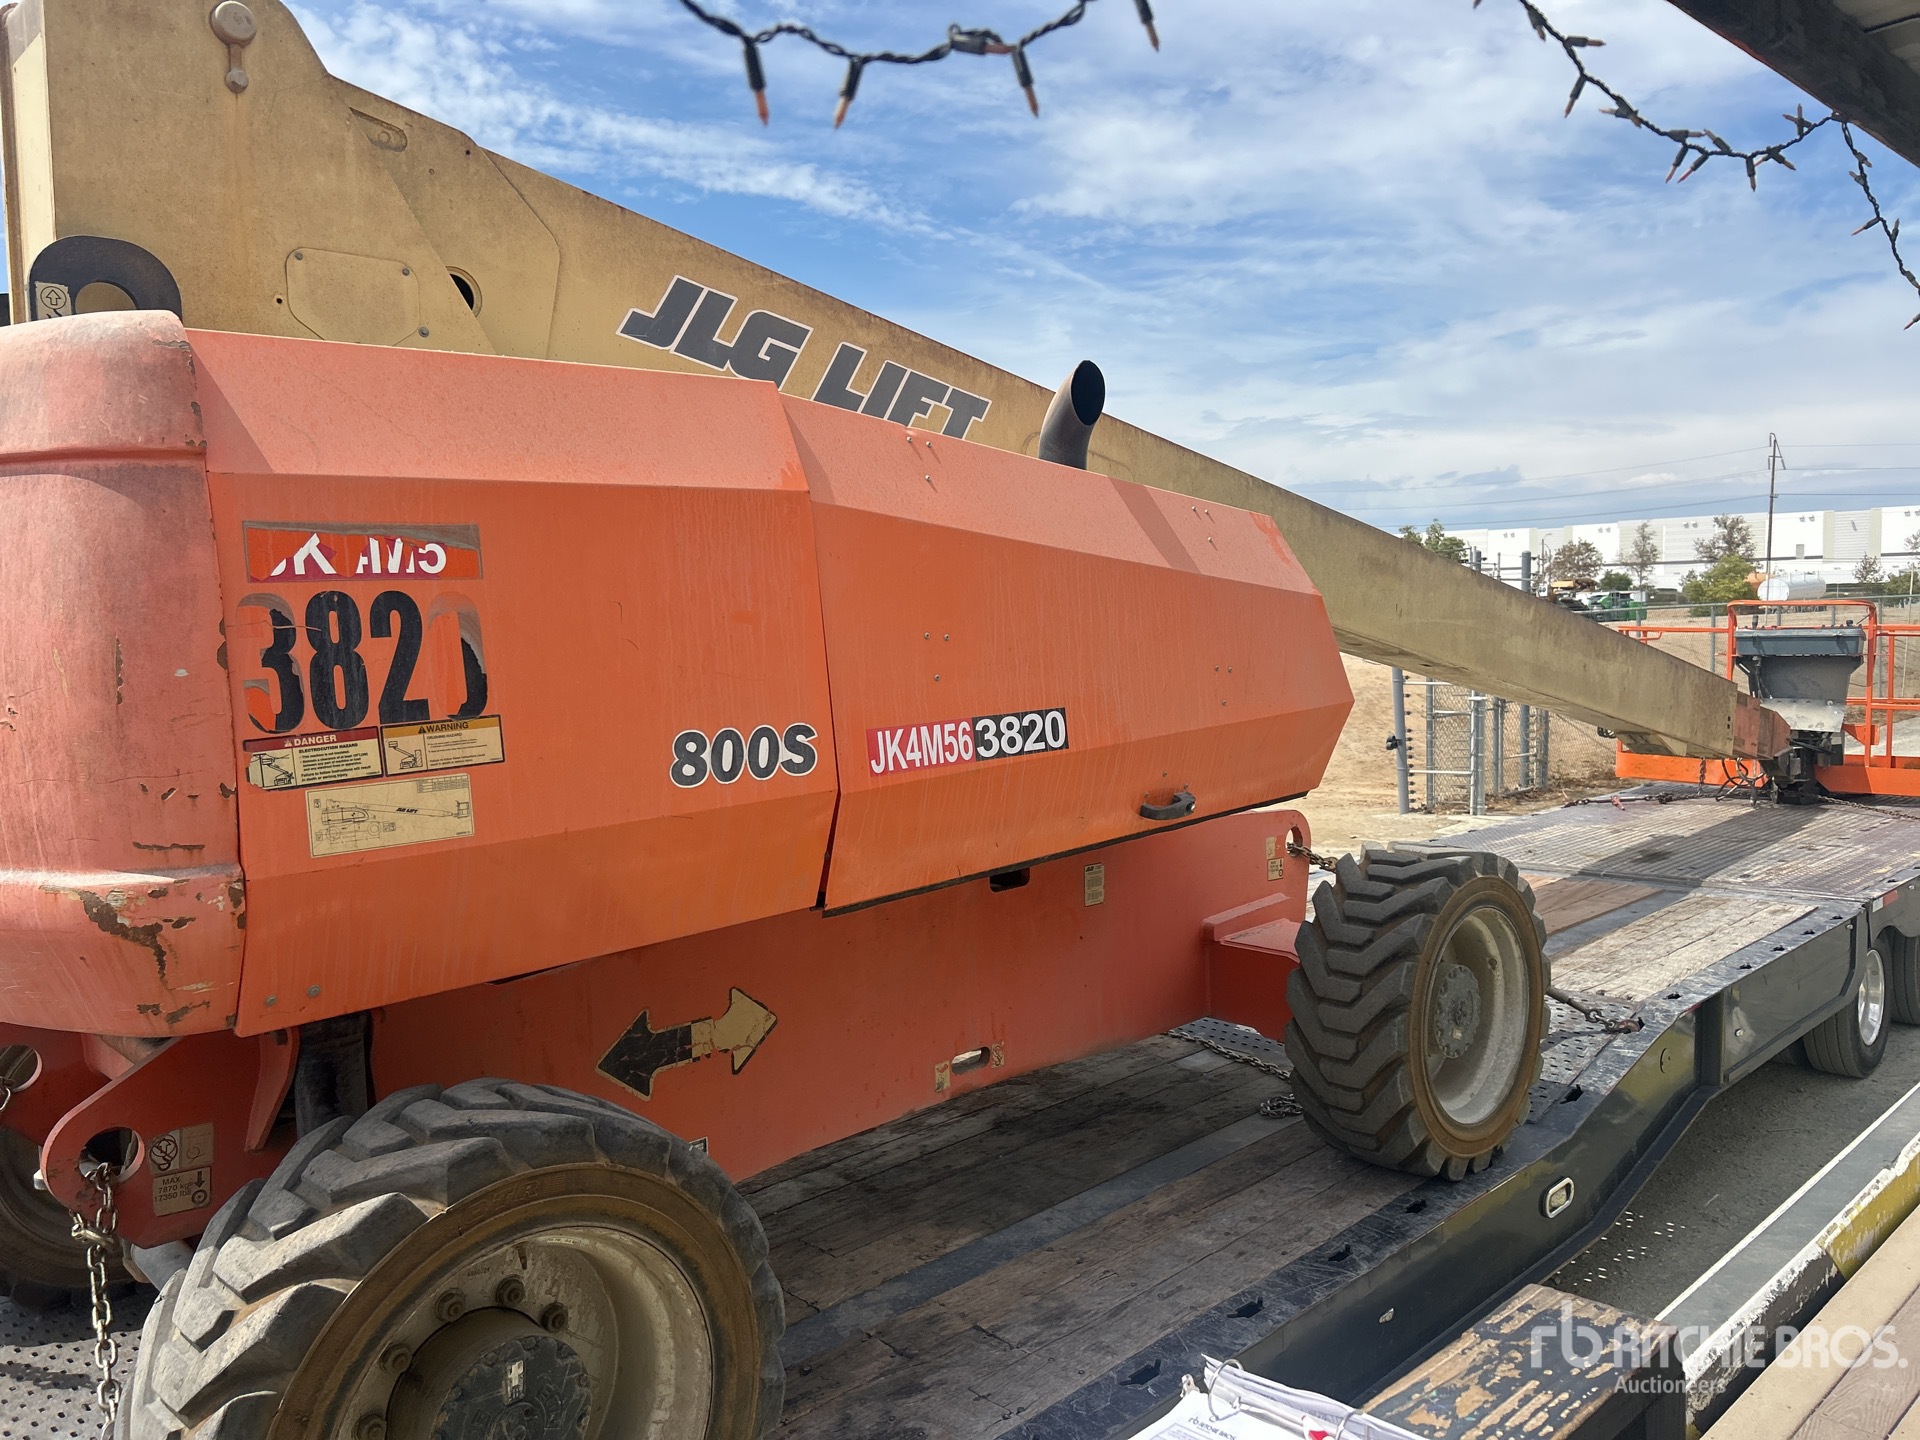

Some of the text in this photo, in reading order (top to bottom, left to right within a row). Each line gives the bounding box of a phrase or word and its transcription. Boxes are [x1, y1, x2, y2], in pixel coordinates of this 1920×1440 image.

[616, 275, 992, 440] JLG LIFT
[426, 722, 469, 733] WARNING
[294, 734, 337, 747] DANGER
[870, 710, 1066, 774] JK4M56 3820
[670, 722, 818, 788] 800S
[162, 1176, 181, 1185] MAX
[158, 1184, 178, 1194] 7870
[154, 1191, 178, 1202] 17350
